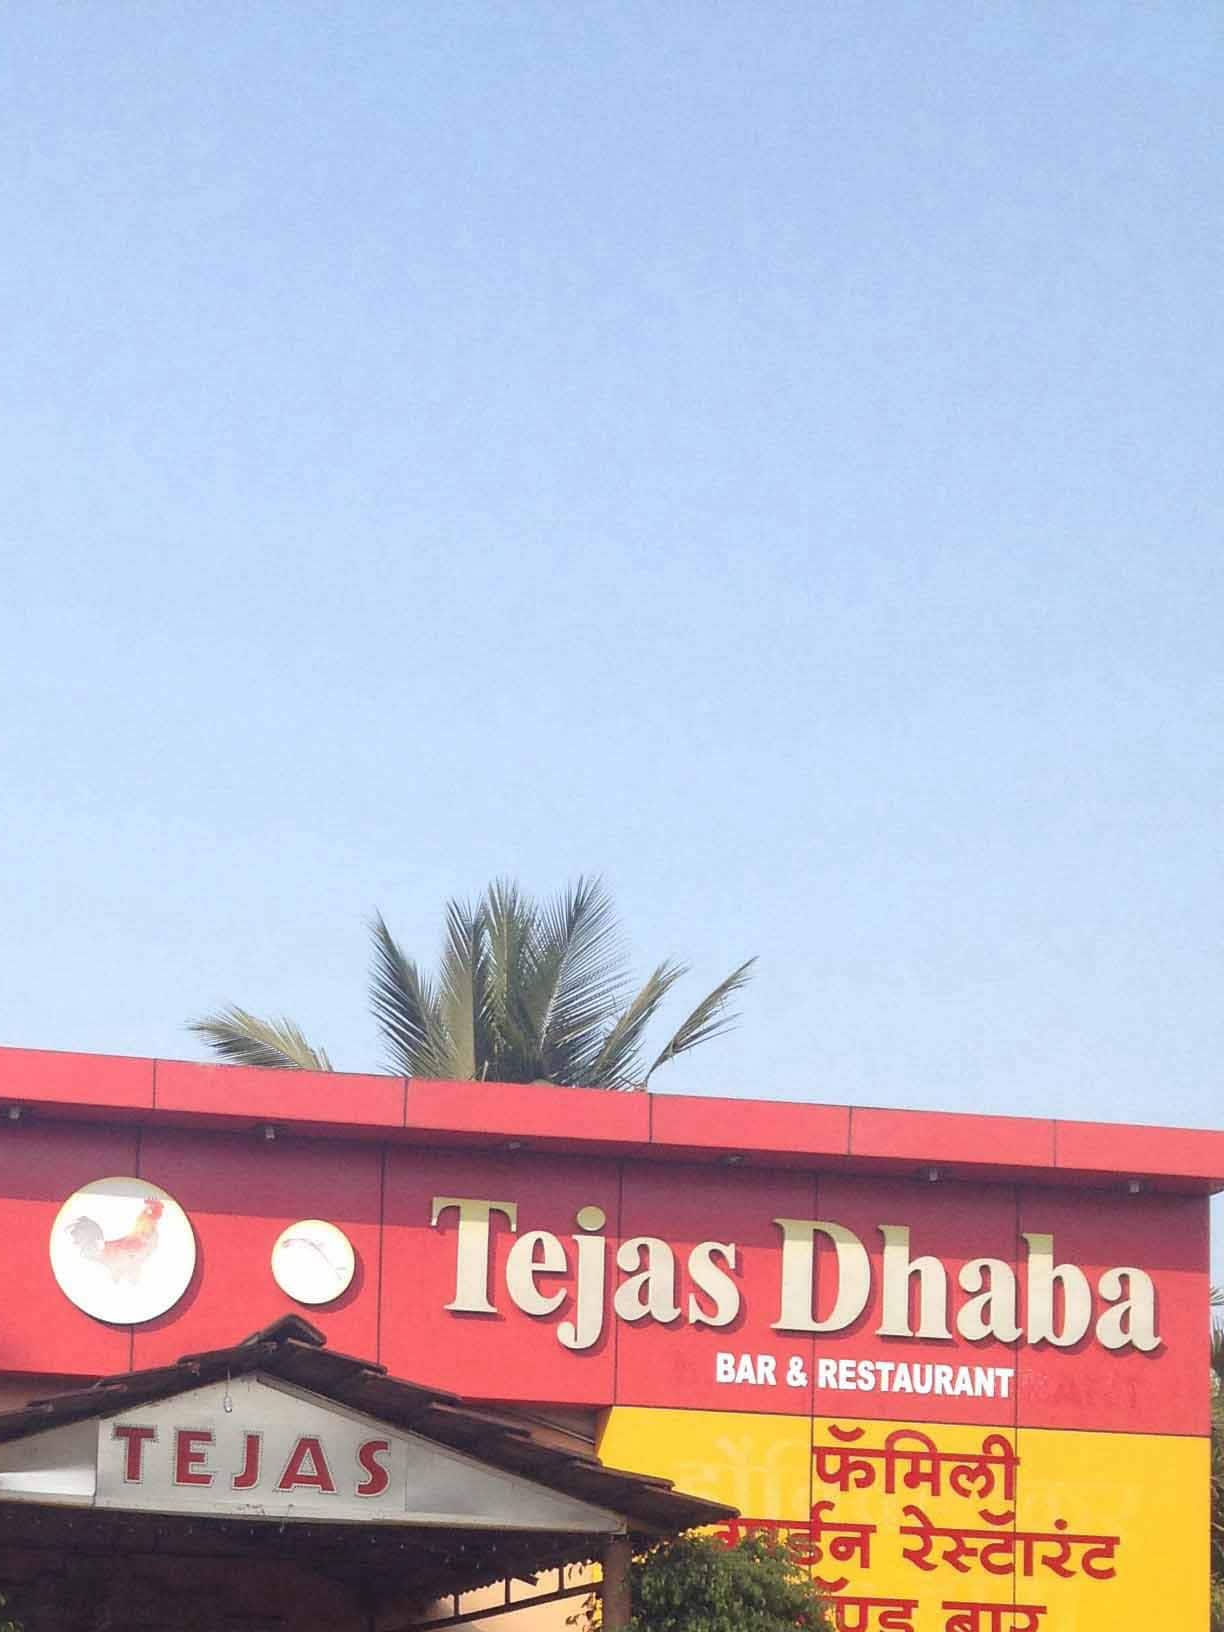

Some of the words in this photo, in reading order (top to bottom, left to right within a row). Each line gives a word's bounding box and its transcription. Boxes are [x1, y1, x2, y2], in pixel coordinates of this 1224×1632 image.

[430, 1196, 742, 1350] Tejas
[770, 1218, 1164, 1353] Dhaba
[715, 1351, 777, 1386] BAR
[785, 1357, 808, 1388] &
[817, 1358, 1015, 1399] RESTAURANT
[112, 1424, 392, 1498] TEJAS
[812, 1424, 1021, 1500] फॅमिली
